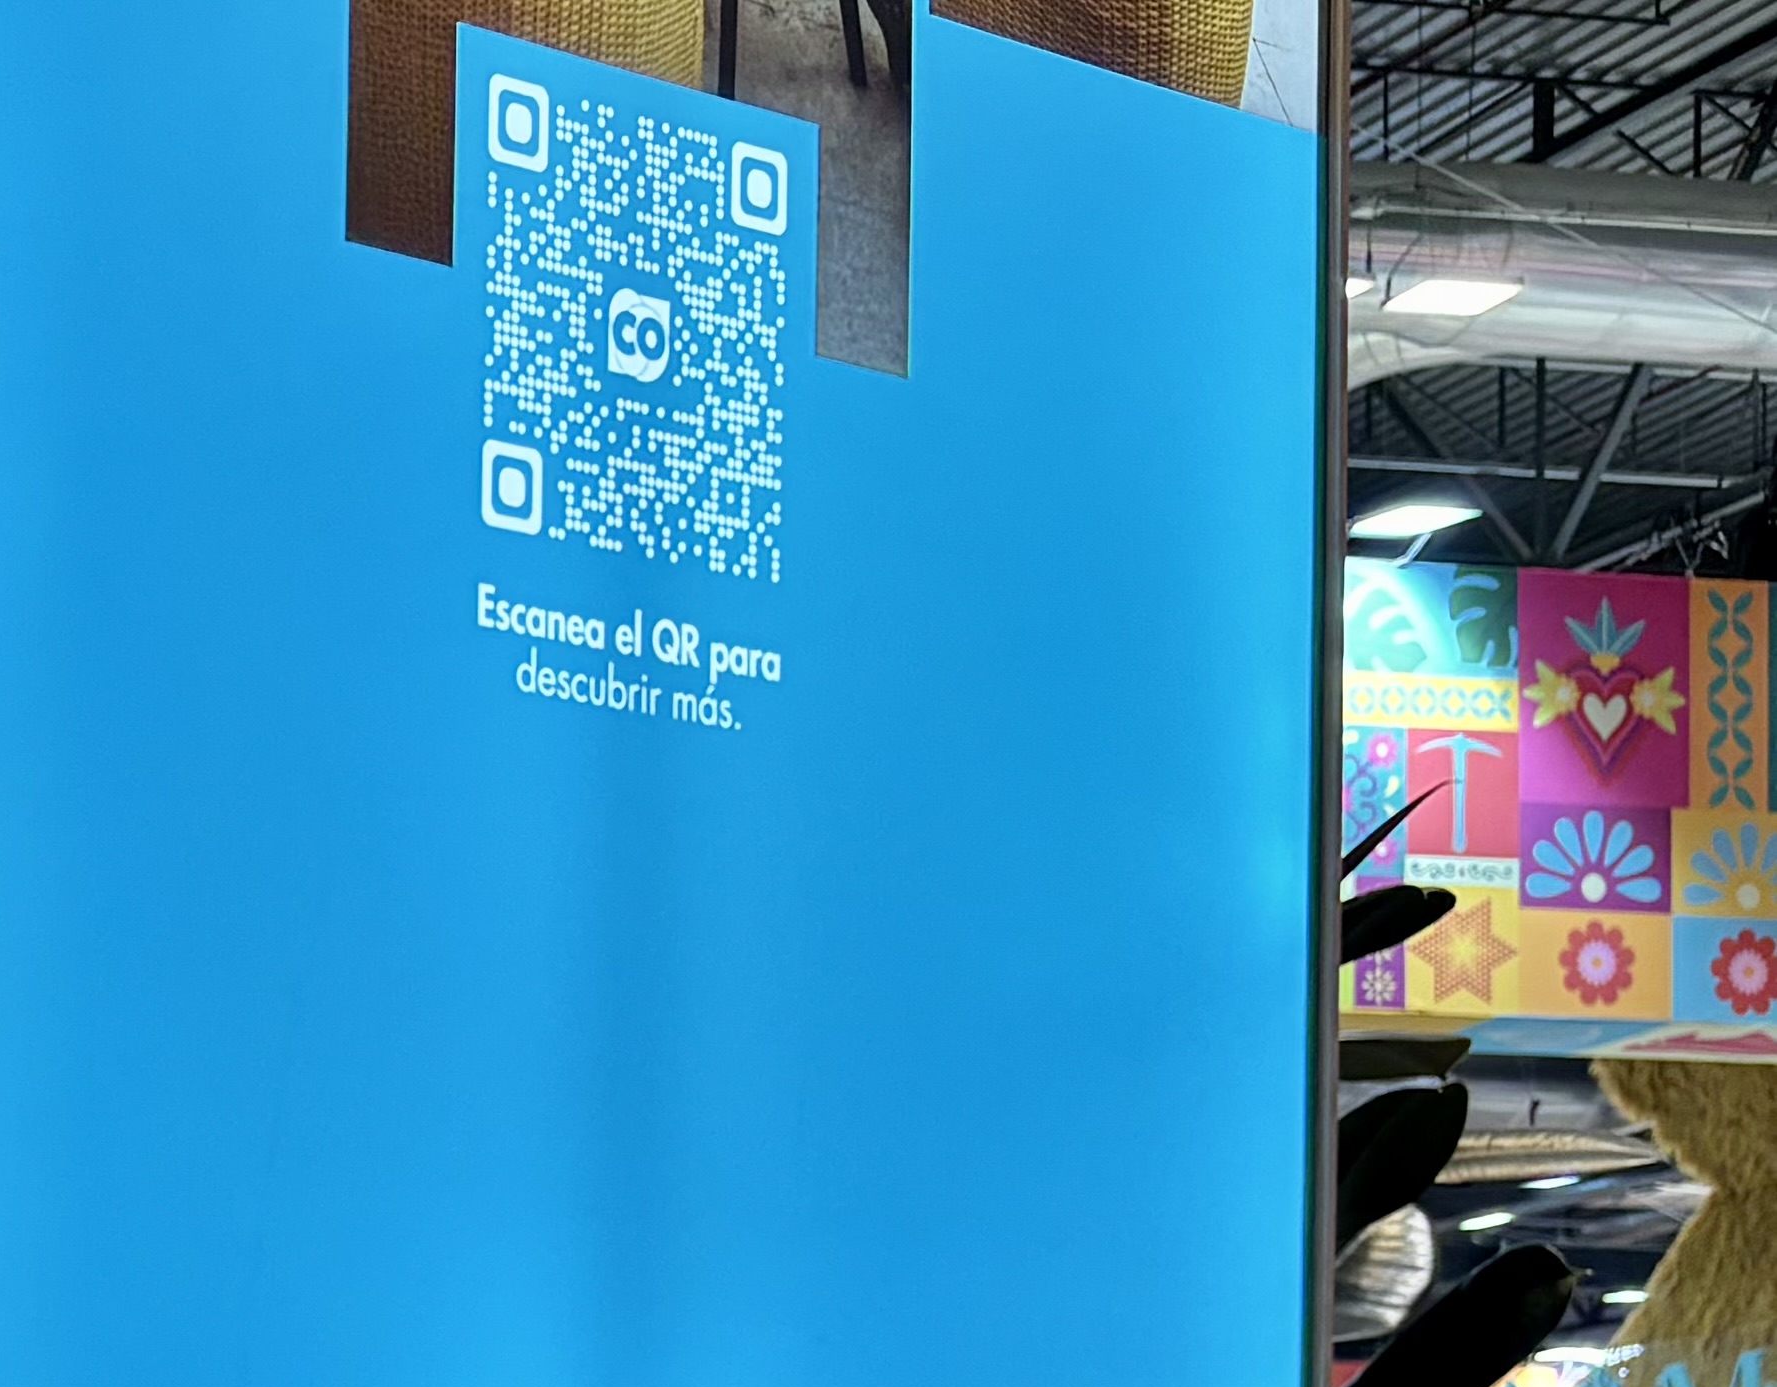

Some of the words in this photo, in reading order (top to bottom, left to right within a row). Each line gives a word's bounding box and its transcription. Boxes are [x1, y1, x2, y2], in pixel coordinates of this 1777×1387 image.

[477, 582, 605, 650] Escanea
[614, 608, 643, 658] el
[651, 617, 700, 668] QR
[709, 642, 781, 686] para
[516, 646, 662, 716] descubrir
[672, 684, 742, 730] más.
